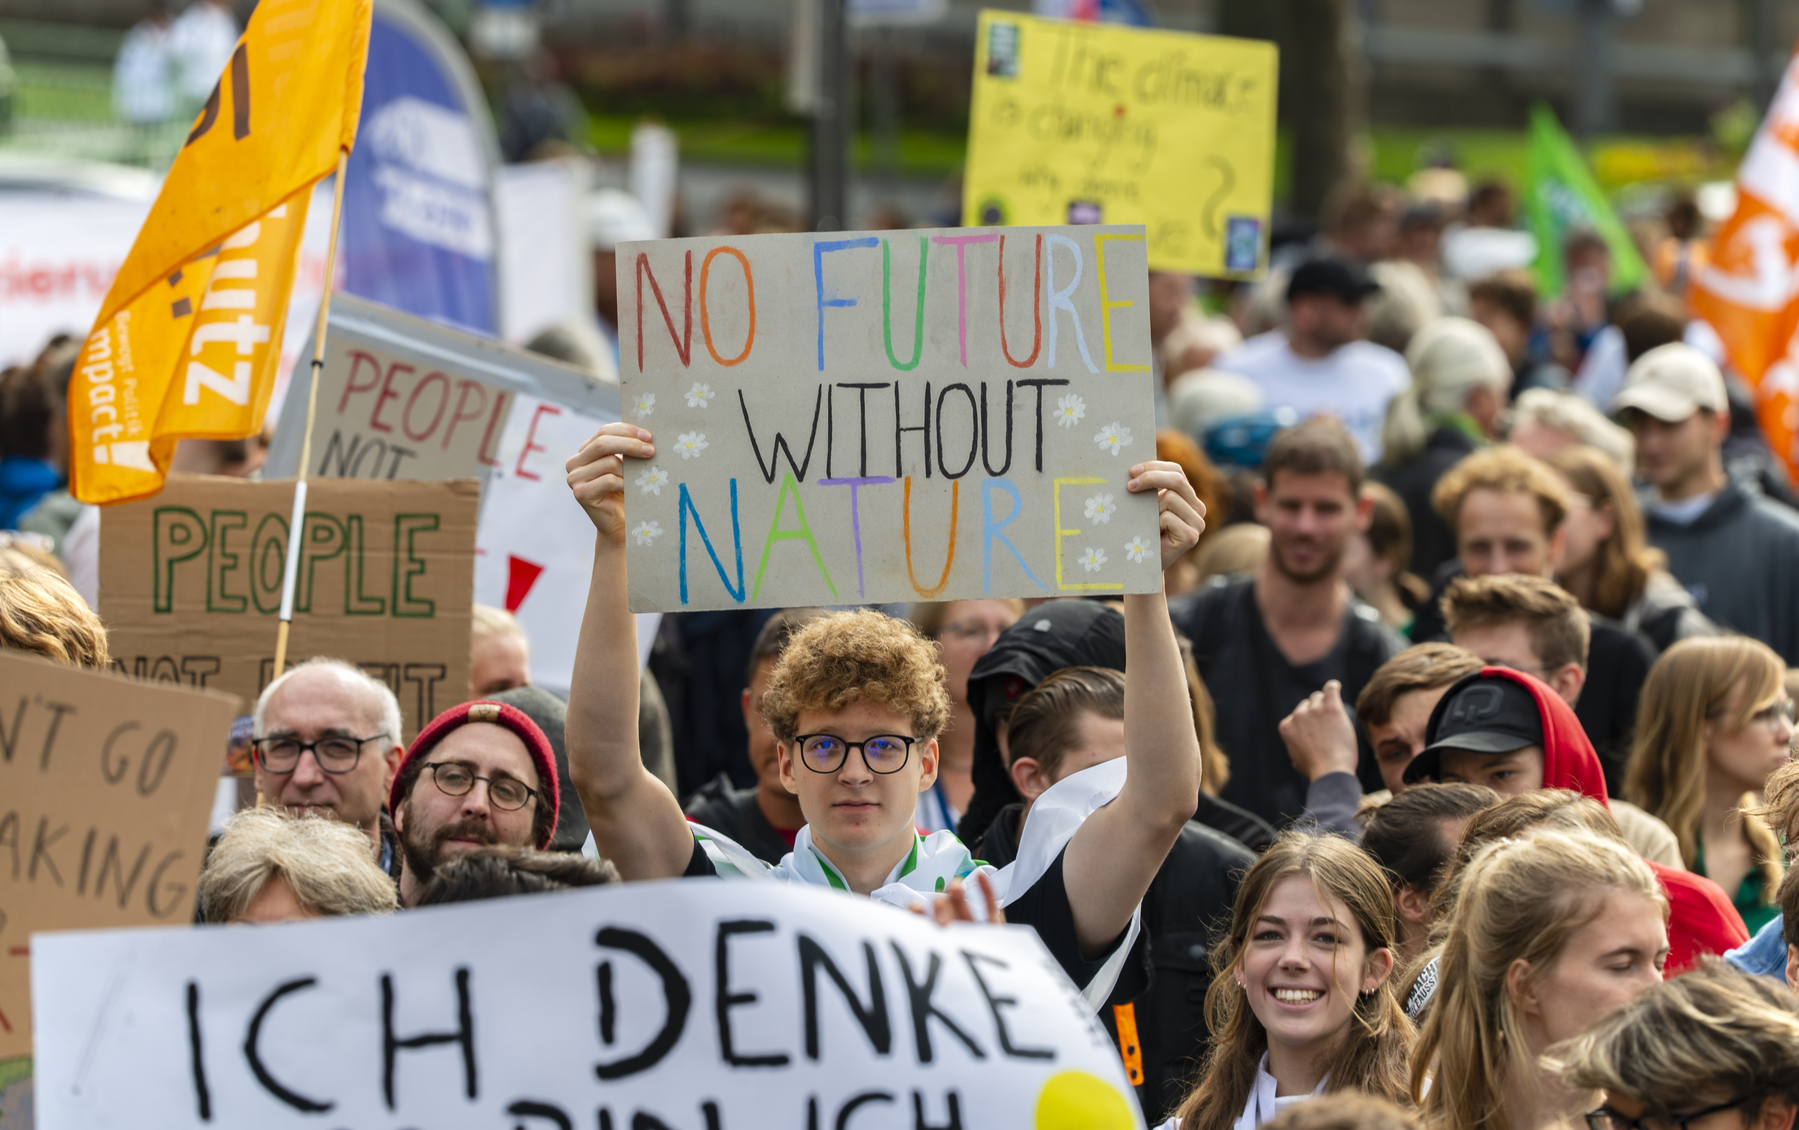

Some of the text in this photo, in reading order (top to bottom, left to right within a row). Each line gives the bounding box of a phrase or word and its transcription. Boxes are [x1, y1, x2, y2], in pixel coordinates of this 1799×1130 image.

[636, 233, 1151, 375] NO FUTURE
[122, 377, 144, 438] Politik
[336, 348, 563, 482] PEOPLE
[738, 379, 1069, 484] WITHOUT
[153, 506, 440, 618] PEOPLE
[678, 473, 1124, 605] NATURE
[101, 719, 179, 799] GO
[182, 966, 480, 1122] ICH
[595, 918, 1056, 1081] DENKE
